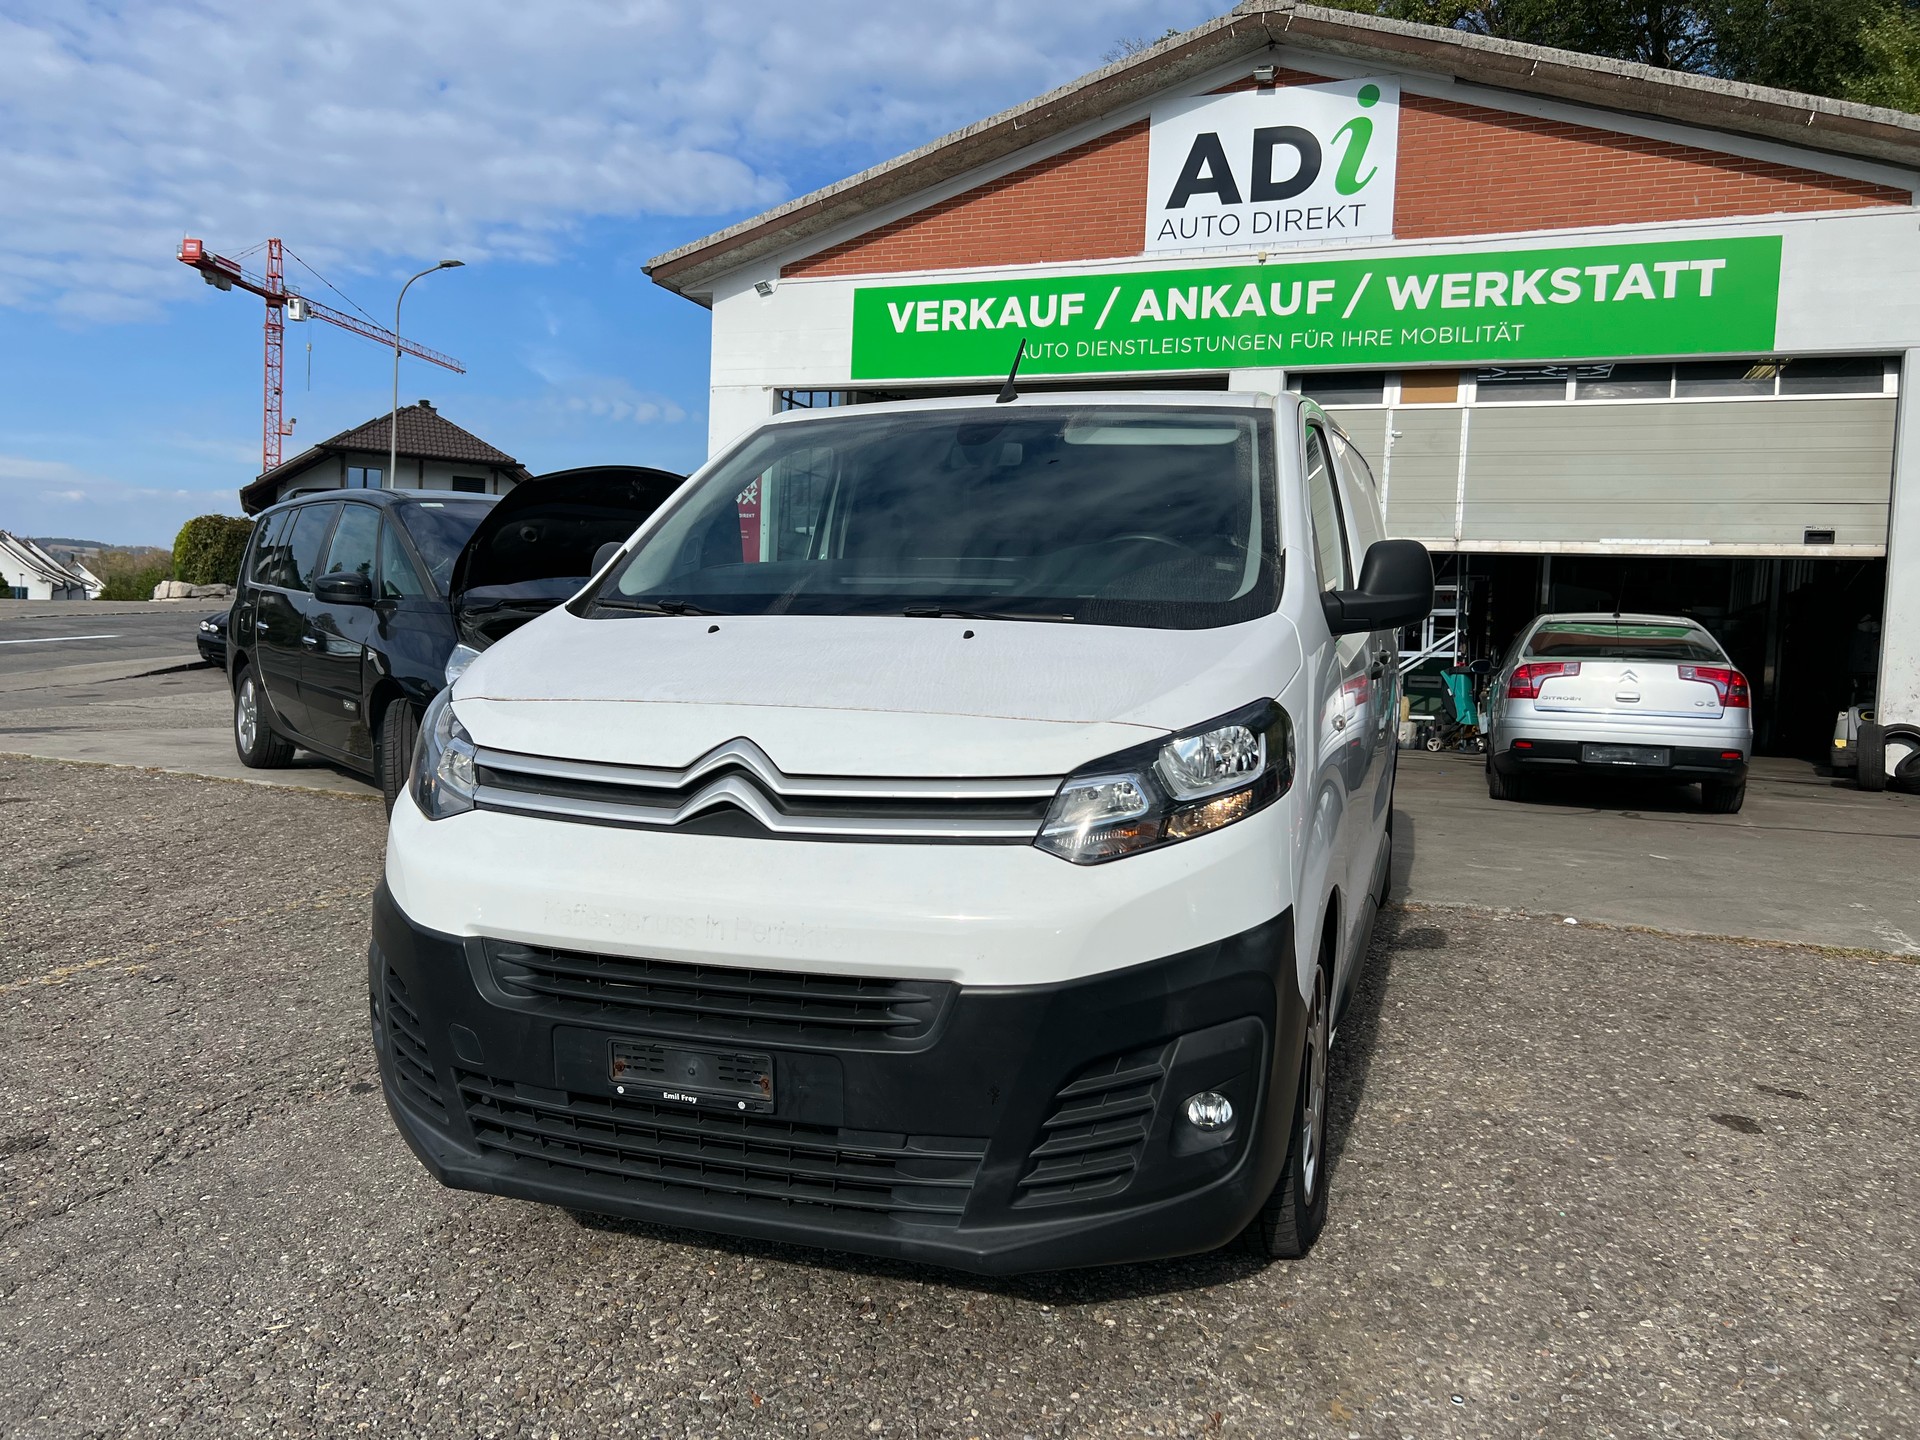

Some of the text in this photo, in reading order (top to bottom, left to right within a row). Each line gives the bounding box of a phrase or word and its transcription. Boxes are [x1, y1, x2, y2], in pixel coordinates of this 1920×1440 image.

[1157, 204, 1367, 241] AUTO DIREKT
[887, 292, 1086, 333] VERKAUF
[1130, 279, 1336, 323] ANKAUF
[1386, 258, 1726, 311] WERKSTATT
[1077, 333, 1282, 357] DIENSTLEISTUNGEN
[1290, 327, 1334, 349] FÜR
[1341, 328, 1393, 347] IHRE
[1400, 321, 1525, 345] MOBILITÄT
[663, 1092, 697, 1104] Emil Frey
